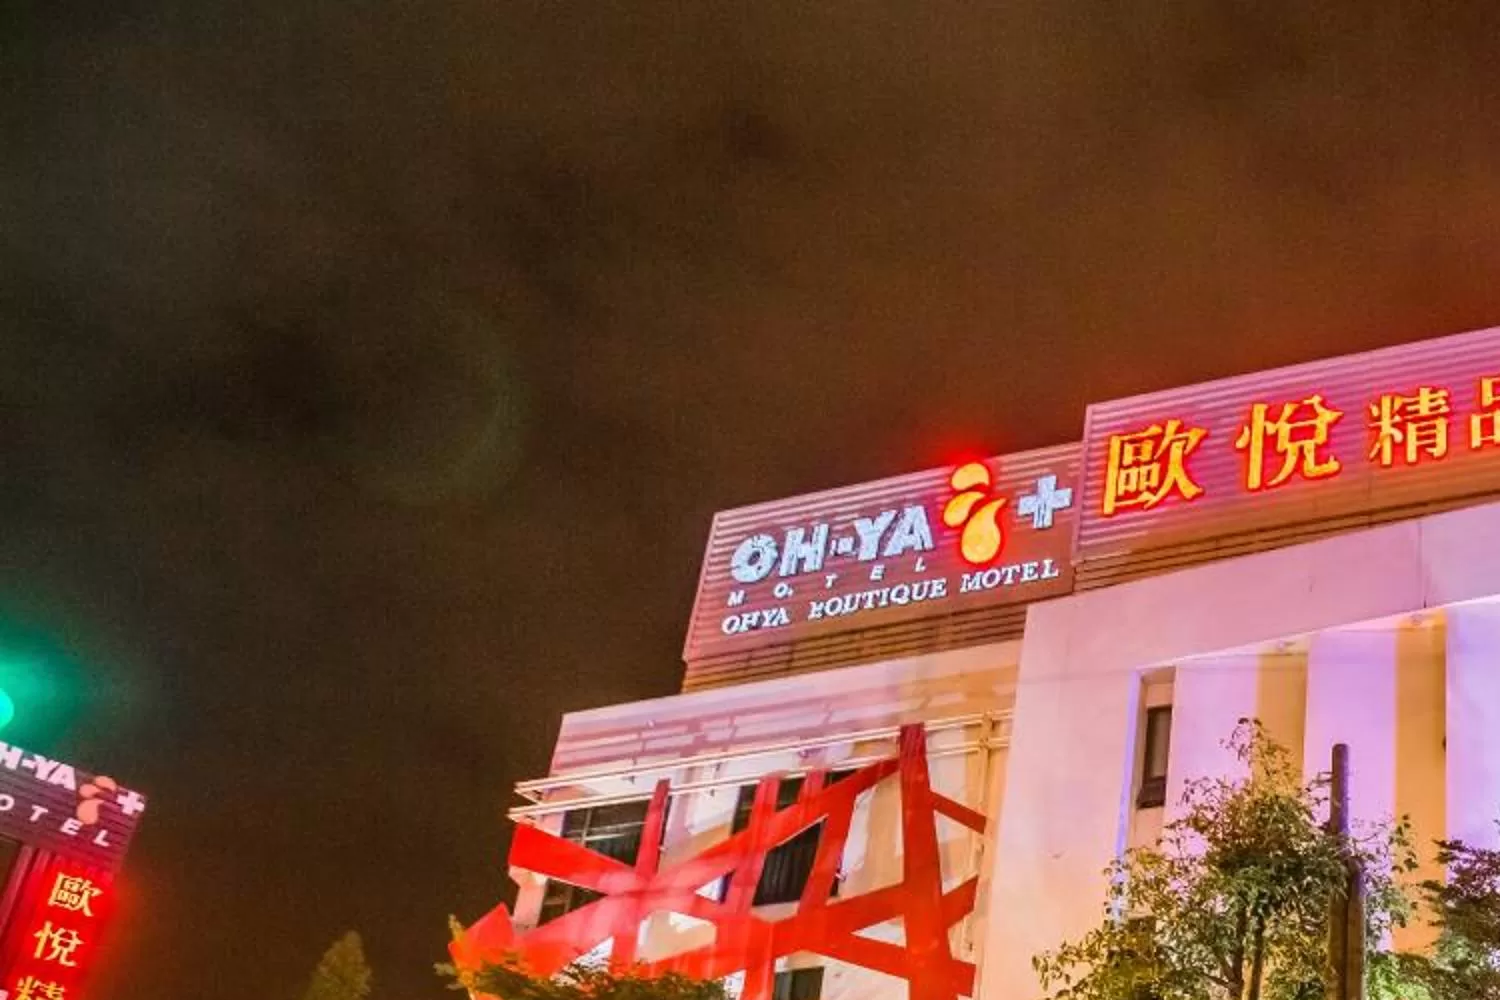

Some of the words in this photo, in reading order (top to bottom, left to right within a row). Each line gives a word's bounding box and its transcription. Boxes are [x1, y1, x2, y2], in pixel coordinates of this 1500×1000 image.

[731, 505, 935, 583] OH-YA
[721, 608, 790, 634] OHYA
[960, 559, 1060, 593] MOTEL
